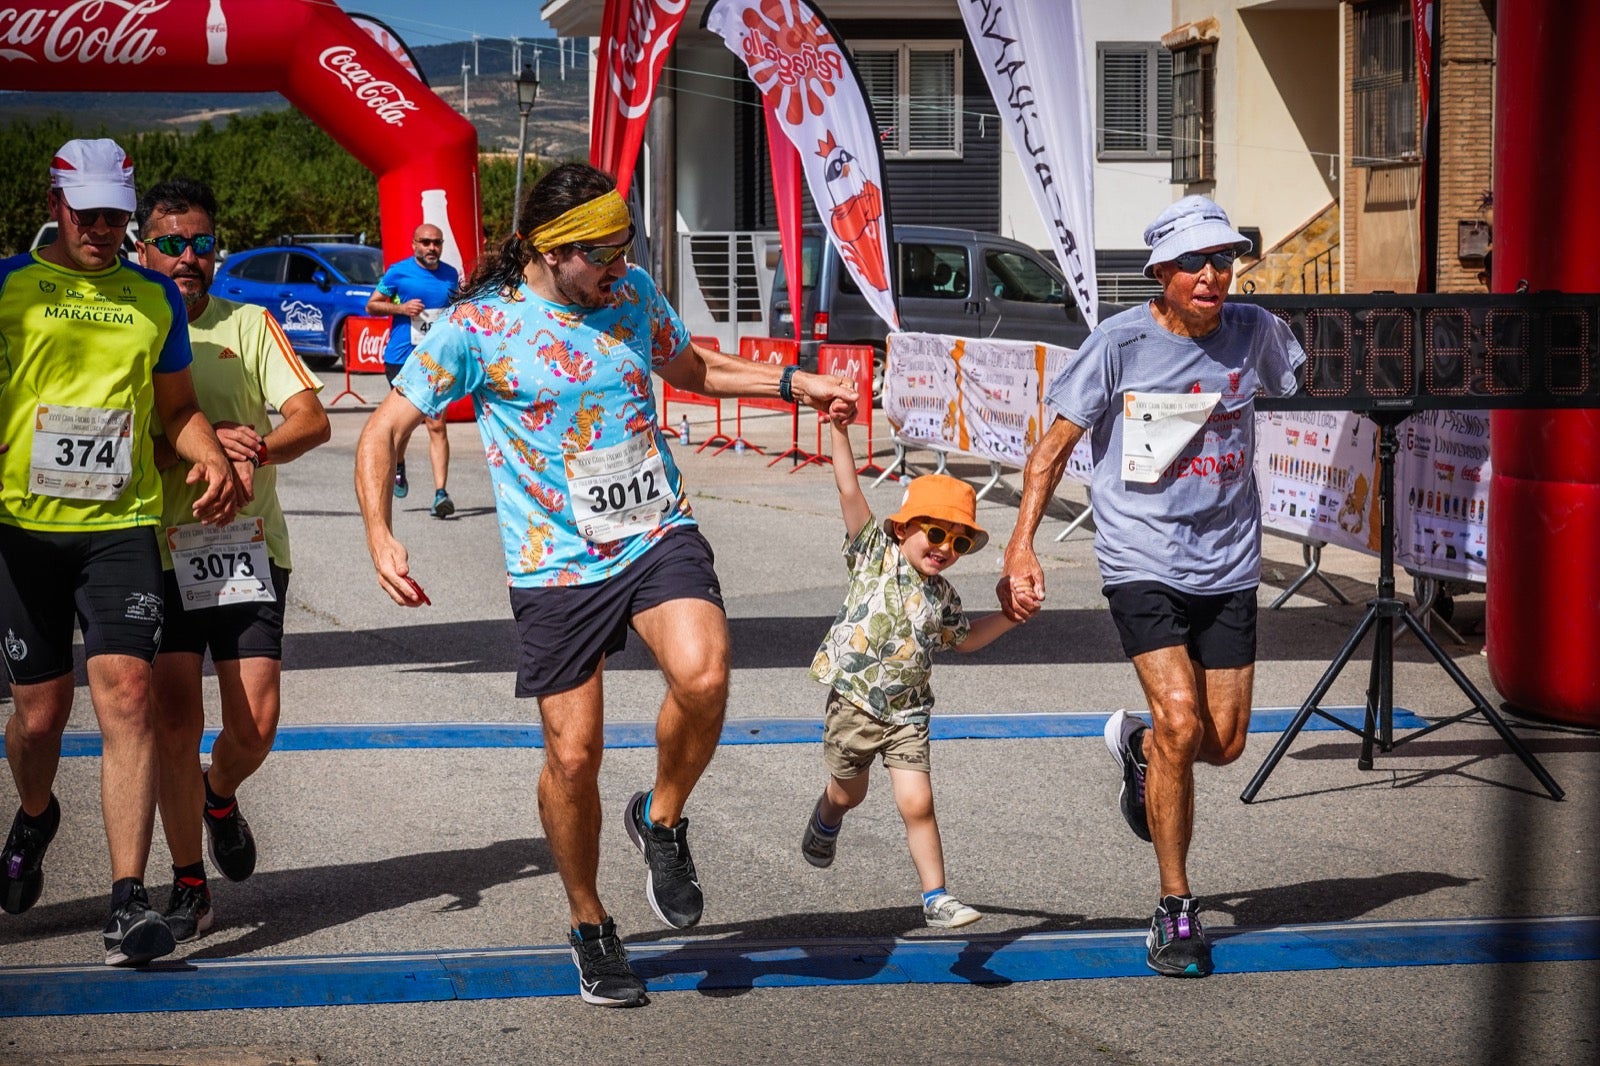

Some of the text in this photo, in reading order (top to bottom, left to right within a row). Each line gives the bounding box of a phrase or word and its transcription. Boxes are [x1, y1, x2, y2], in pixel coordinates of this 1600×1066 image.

[319, 45, 419, 127] Coca-Cola
[44, 306, 134, 324] MARACENA
[55, 437, 115, 469] 374
[588, 470, 661, 513] 3012
[189, 552, 255, 581] 3073
